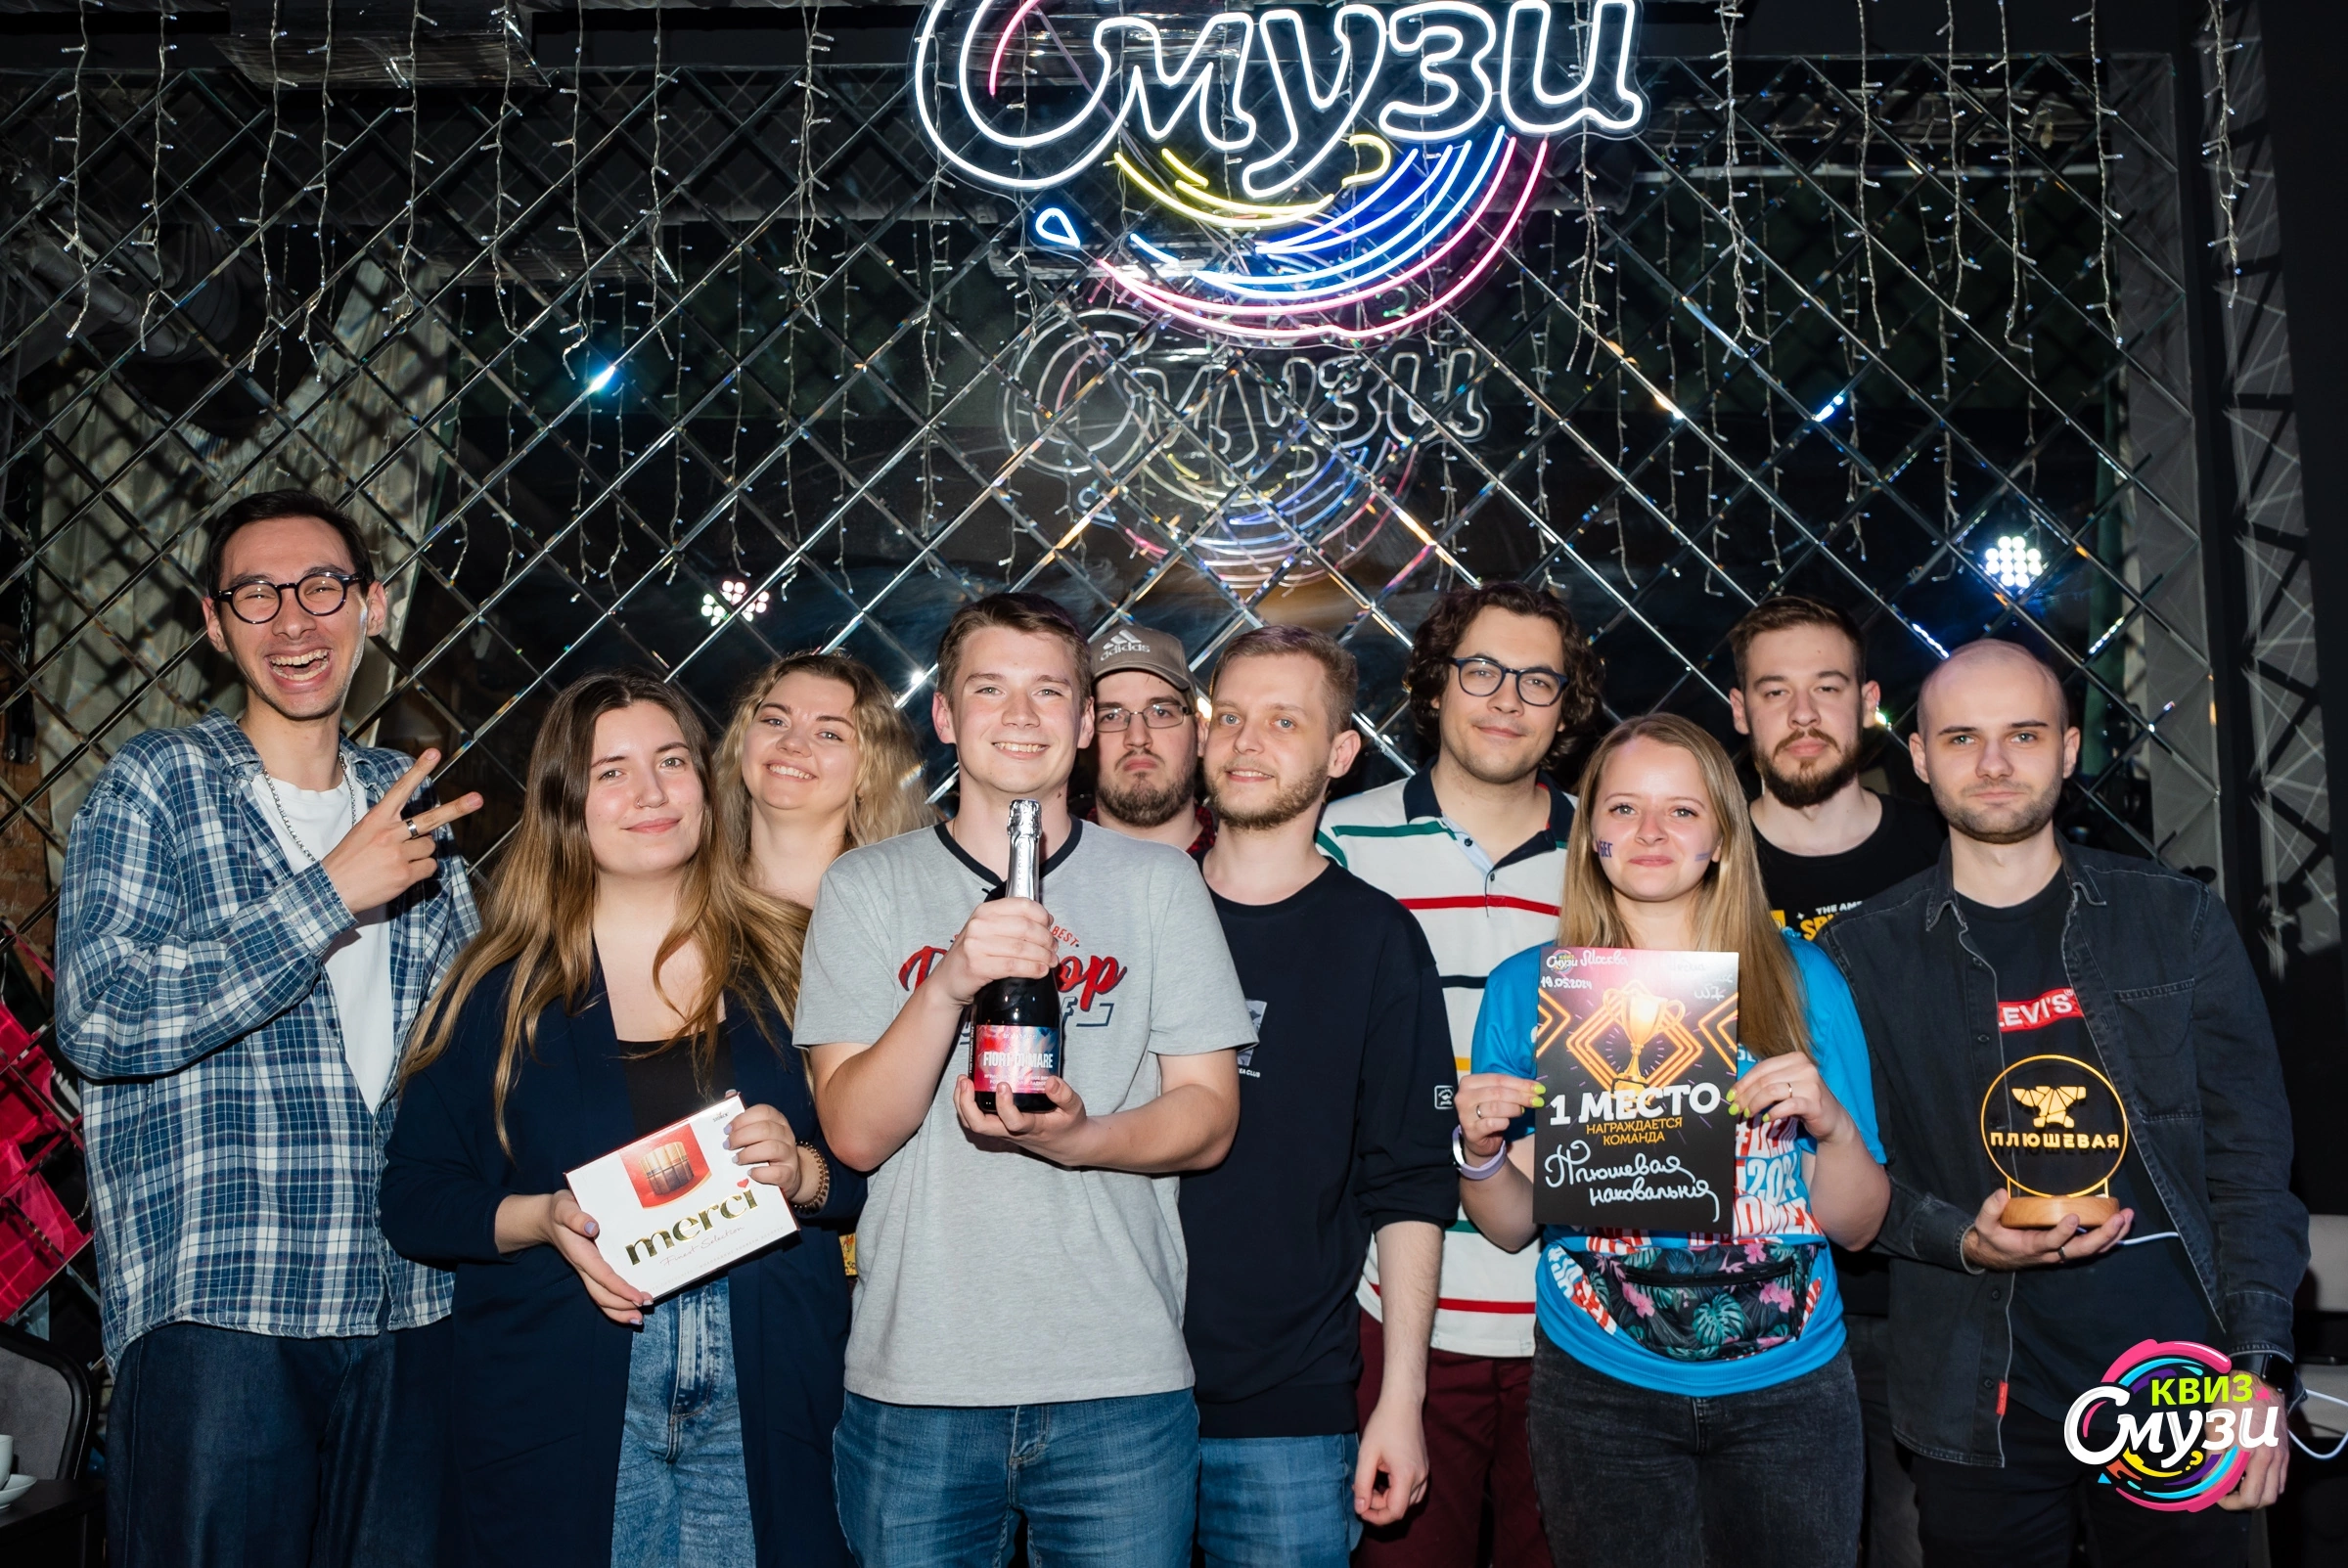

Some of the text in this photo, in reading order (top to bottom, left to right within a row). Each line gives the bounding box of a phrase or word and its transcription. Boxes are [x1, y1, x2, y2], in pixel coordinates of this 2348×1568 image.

[916, 0, 1644, 198] Смузи
[1101, 642, 1151, 661] adidas
[1815, 904, 1837, 916] THE
[1580, 949, 1629, 966] Москва
[1026, 1053, 1054, 1068] MARE
[1550, 1082, 1721, 1125] 1 МЕСТО
[1586, 1117, 1683, 1135] НАГРАЖДАЕТСЯ
[1603, 1131, 1665, 1145] КОМАНДА
[1990, 1132, 2120, 1149] ПЛЮШЕВАЯ
[1544, 1140, 1696, 1188] Плюшевая
[1589, 1177, 1720, 1223] наковальня
[624, 1179, 758, 1266] merci
[659, 1226, 745, 1267] Finest Selection
